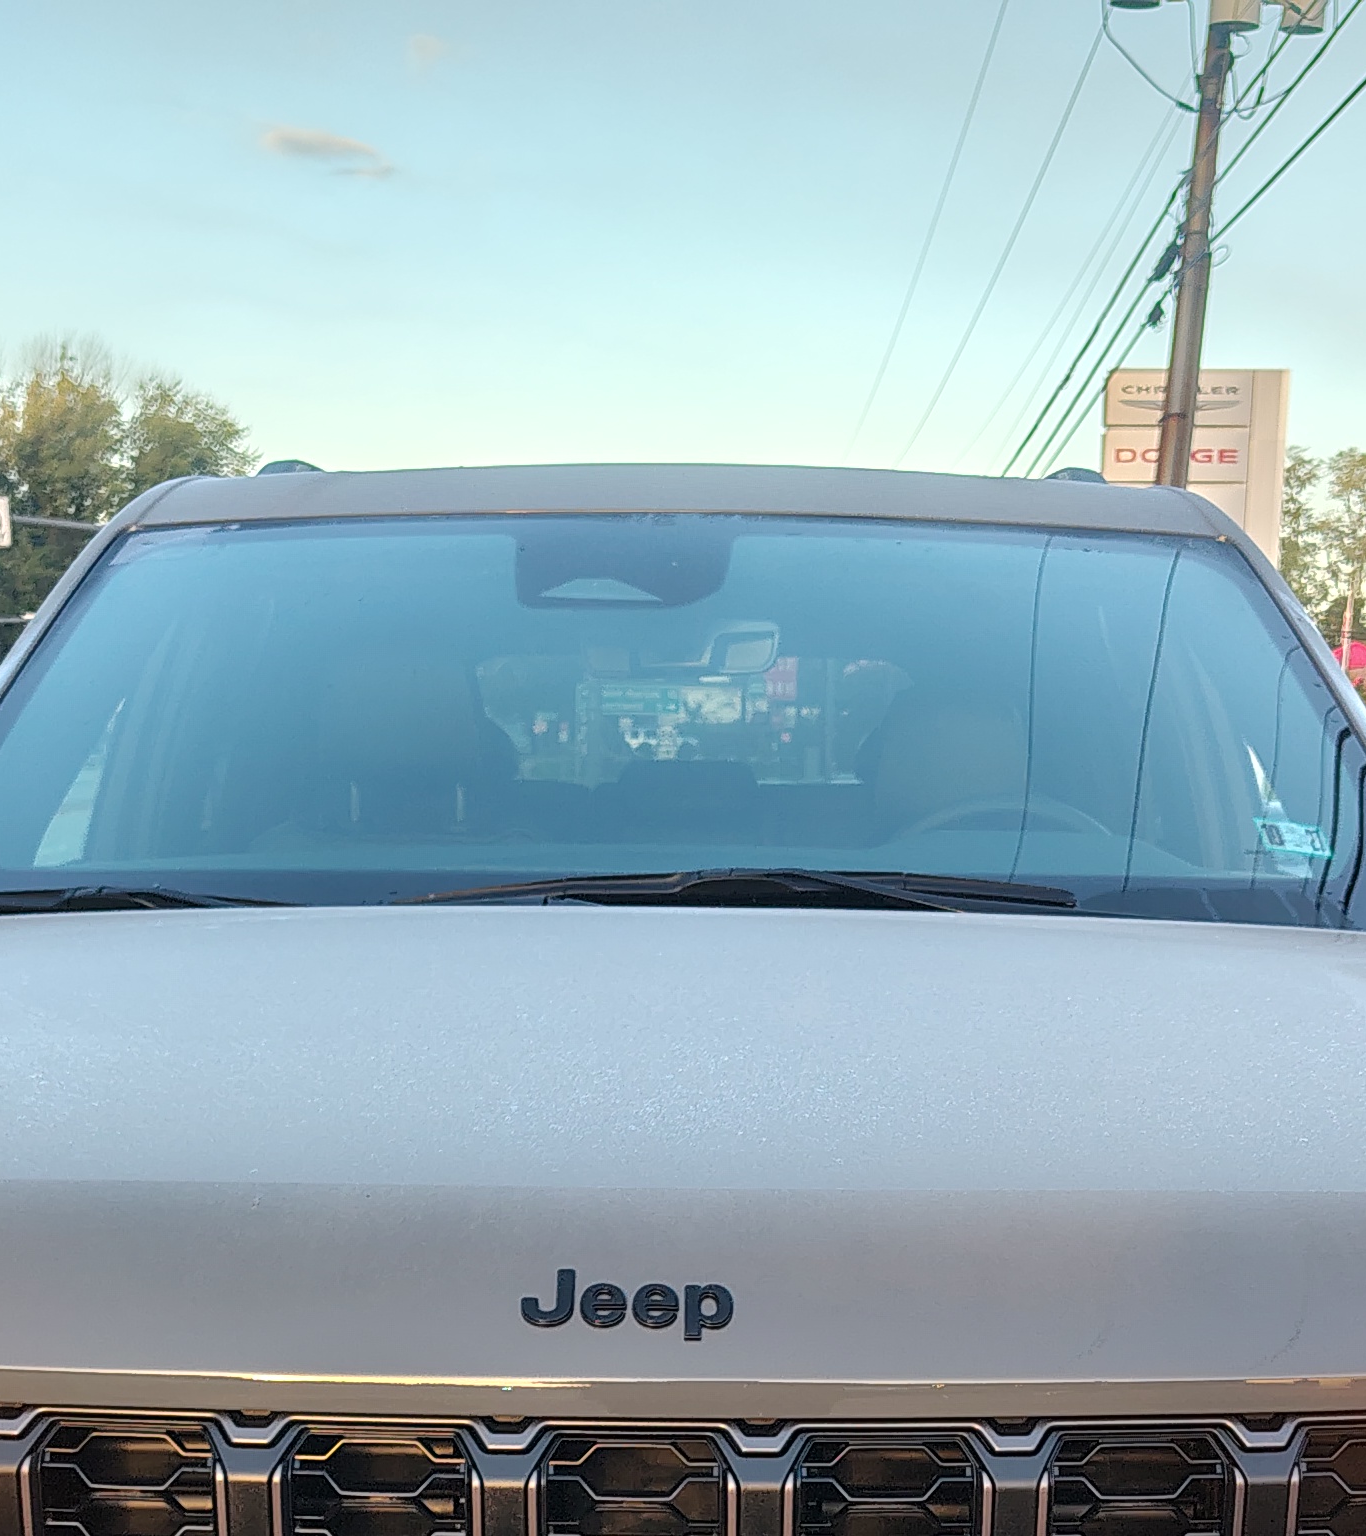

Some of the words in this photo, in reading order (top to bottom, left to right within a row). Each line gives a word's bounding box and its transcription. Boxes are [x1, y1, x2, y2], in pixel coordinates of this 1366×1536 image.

[1121, 385, 1239, 395] CHRLER
[1115, 448, 1239, 464] DOGE
[520, 1268, 734, 1341] Jeep
